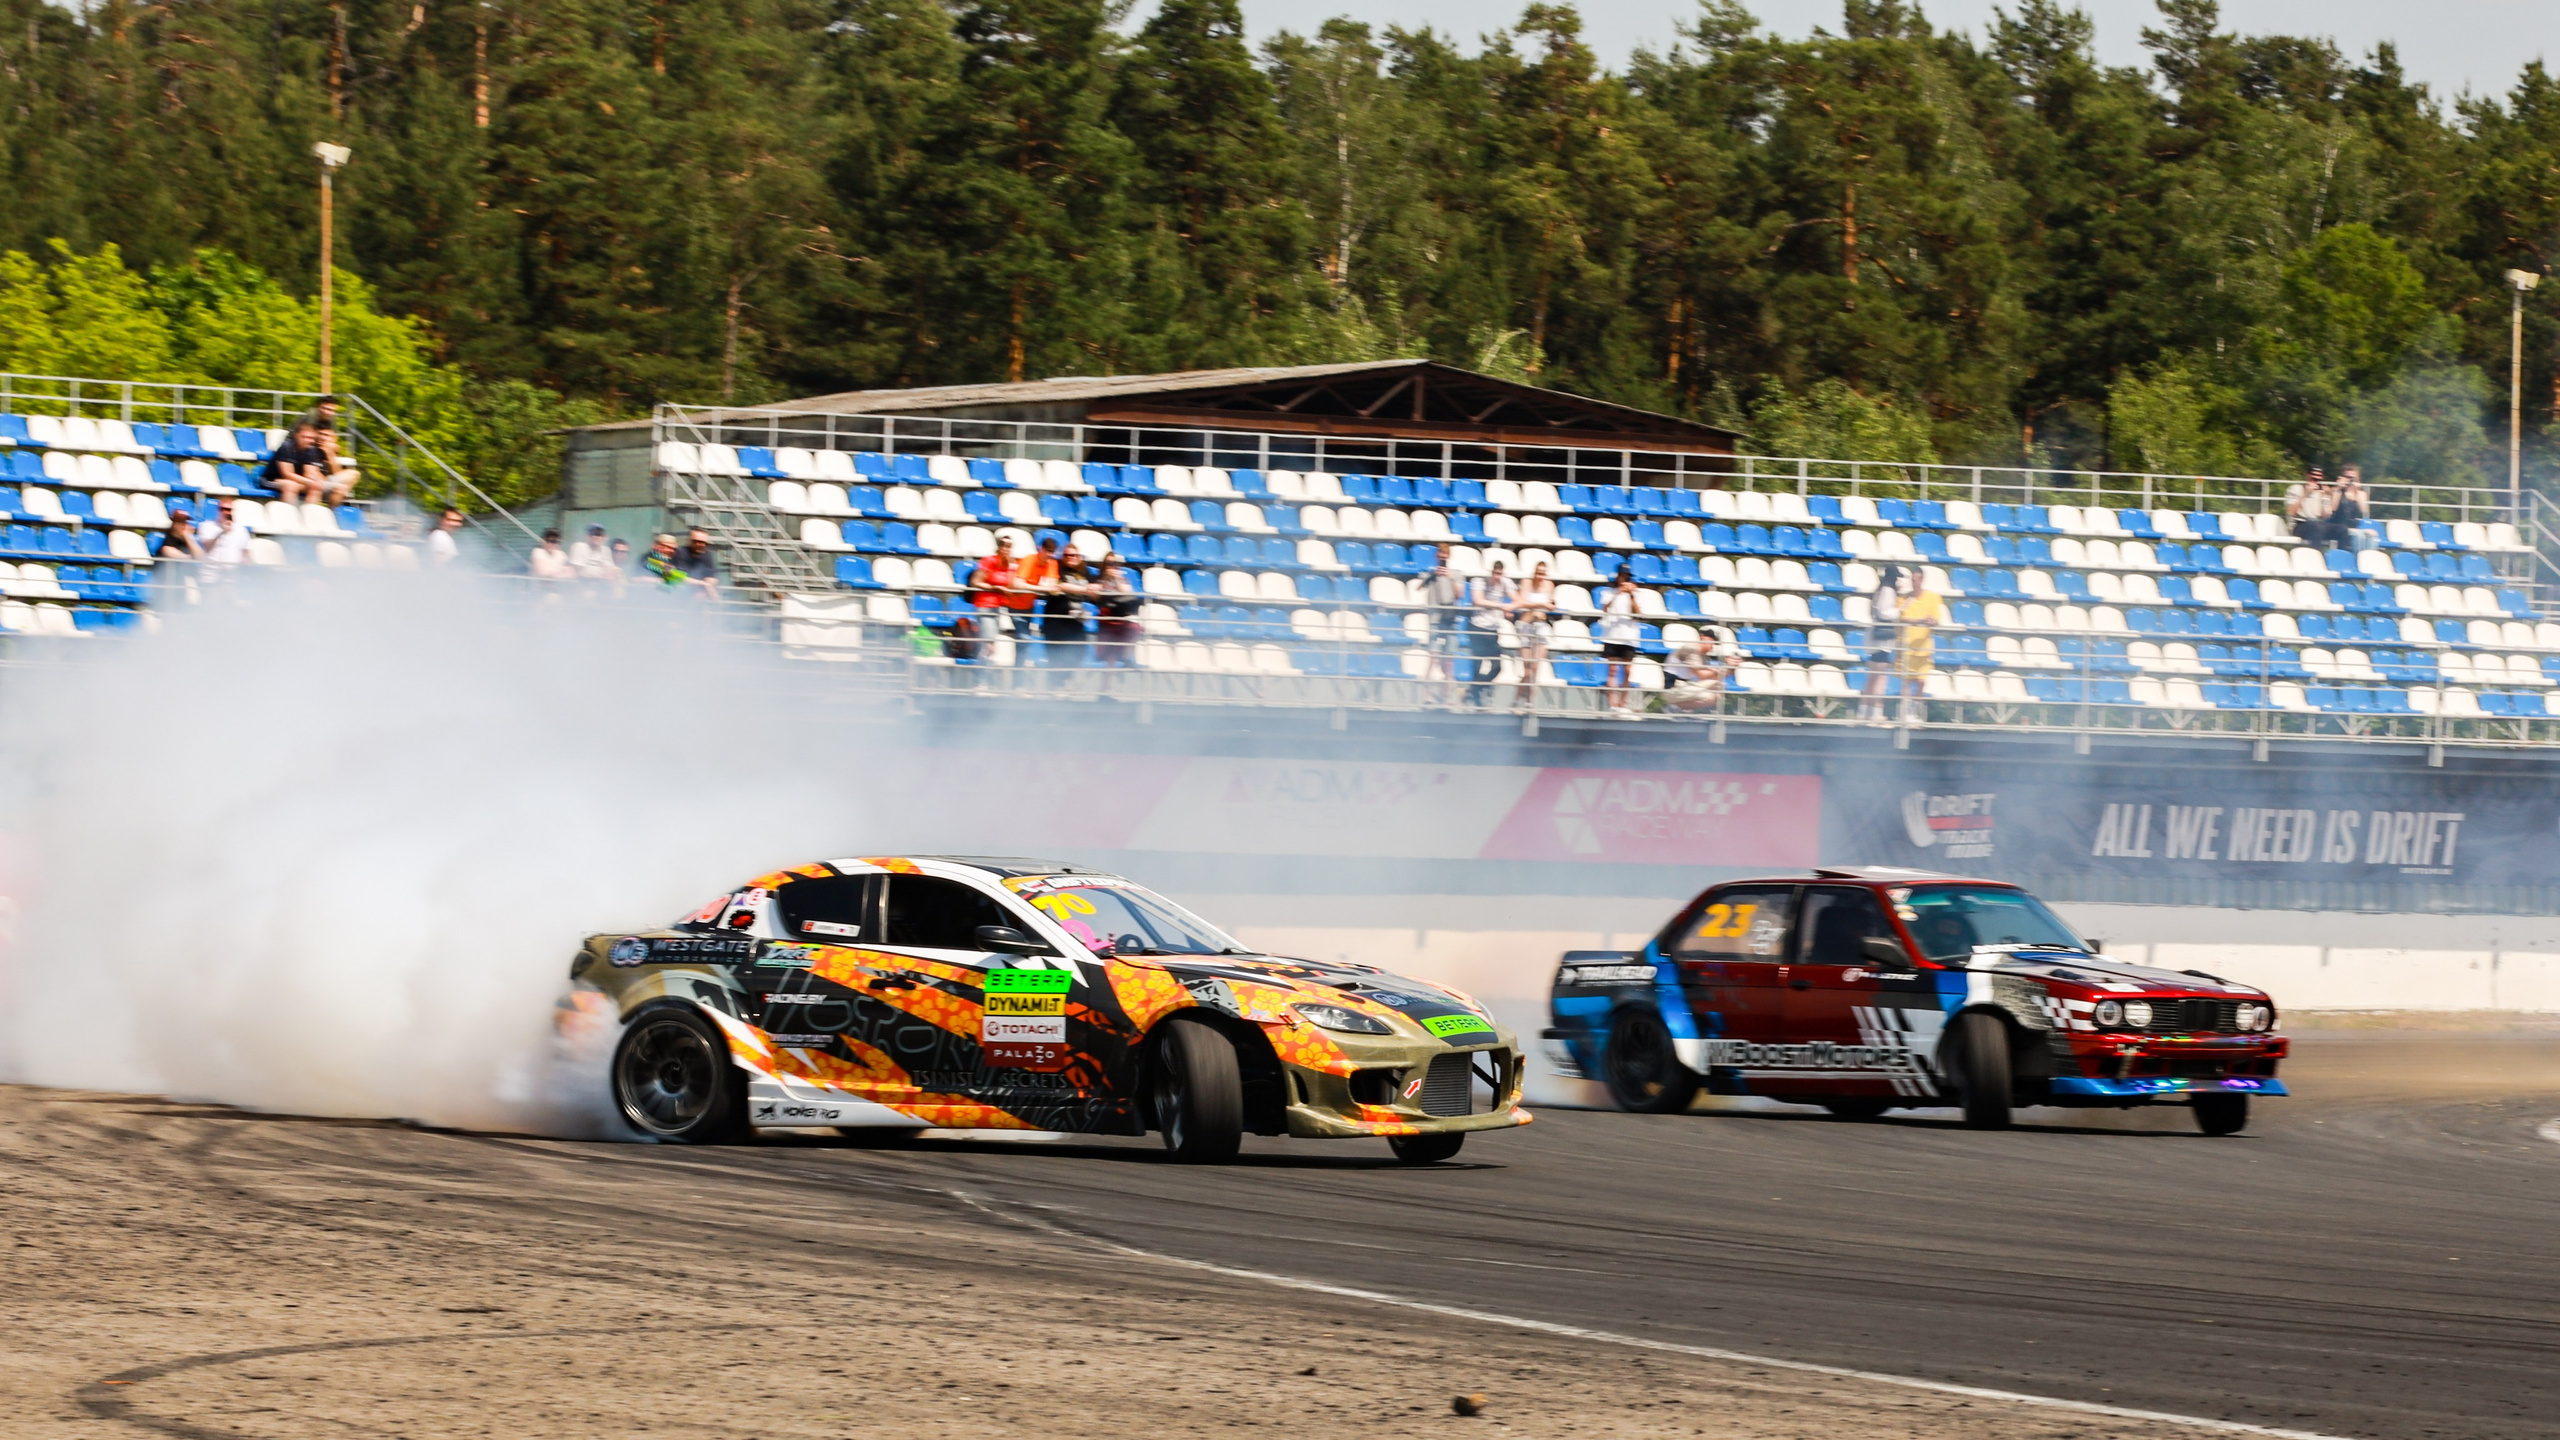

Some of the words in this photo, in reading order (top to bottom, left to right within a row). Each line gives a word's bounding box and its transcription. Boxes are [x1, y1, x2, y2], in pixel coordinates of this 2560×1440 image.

[1601, 779, 1698, 814] ADM
[1928, 793, 1997, 816] DRIFT
[2091, 803, 2153, 858] ALL
[2165, 805, 2224, 860] WE
[2226, 807, 2317, 863] NEED
[2321, 809, 2362, 864] IS
[2365, 811, 2466, 866] DRIFT
[1029, 892, 1097, 921] 70
[1698, 903, 1759, 938] 23
[652, 938, 749, 953] WESTGATE
[1060, 919, 1114, 951] 2
[991, 973, 1066, 987] BETERA
[1001, 1024, 1059, 1035] TOTACHI
[1435, 1018, 1483, 1032] BETERA
[1000, 1072, 1068, 1088] SECRETS
